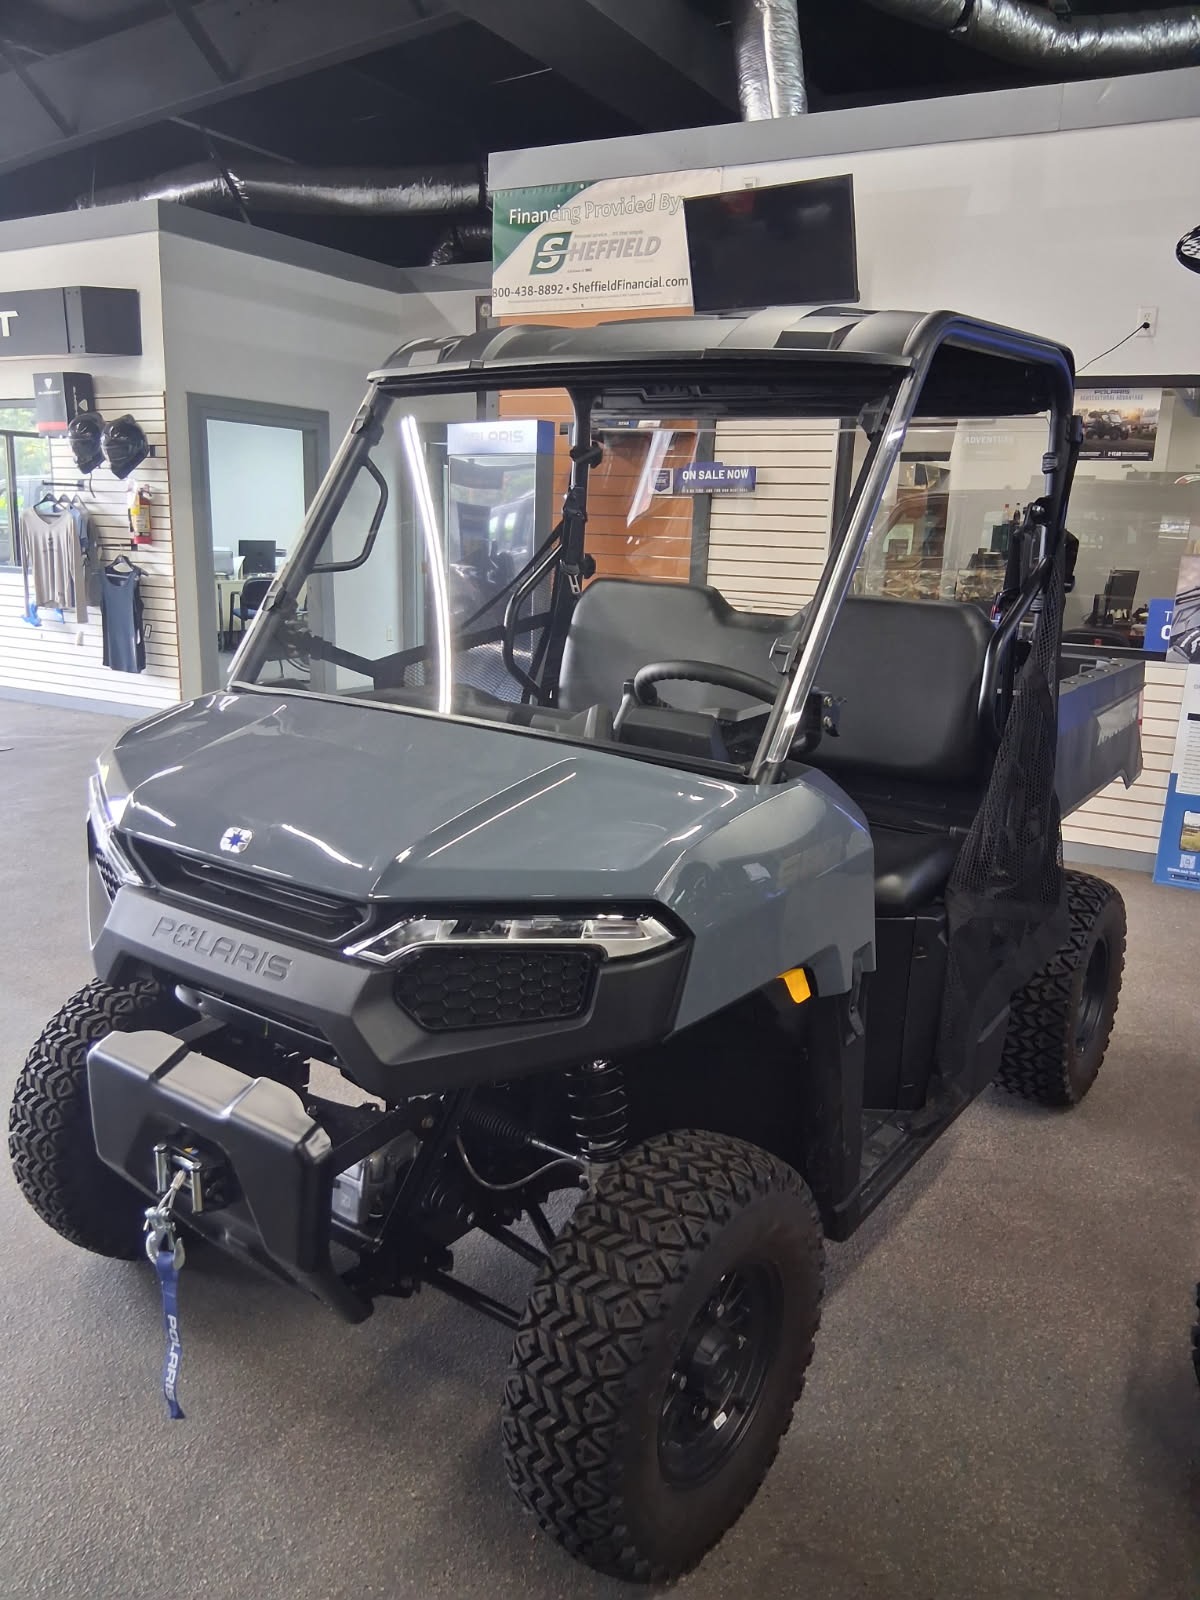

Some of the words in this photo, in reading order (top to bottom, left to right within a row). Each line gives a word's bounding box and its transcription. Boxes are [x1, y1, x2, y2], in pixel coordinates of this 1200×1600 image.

[509, 204, 581, 225] Financing
[585, 194, 655, 219] Provided
[535, 236, 661, 271] SHEFFIELD
[492, 284, 563, 298] 800-438-8892
[572, 276, 689, 293] SheffieldFinancial.com
[682, 470, 696, 480] ON
[698, 469, 725, 480] SALE
[727, 468, 749, 479] NOW
[152, 916, 293, 982] POLARIS
[165, 1314, 181, 1402] POLARIS
